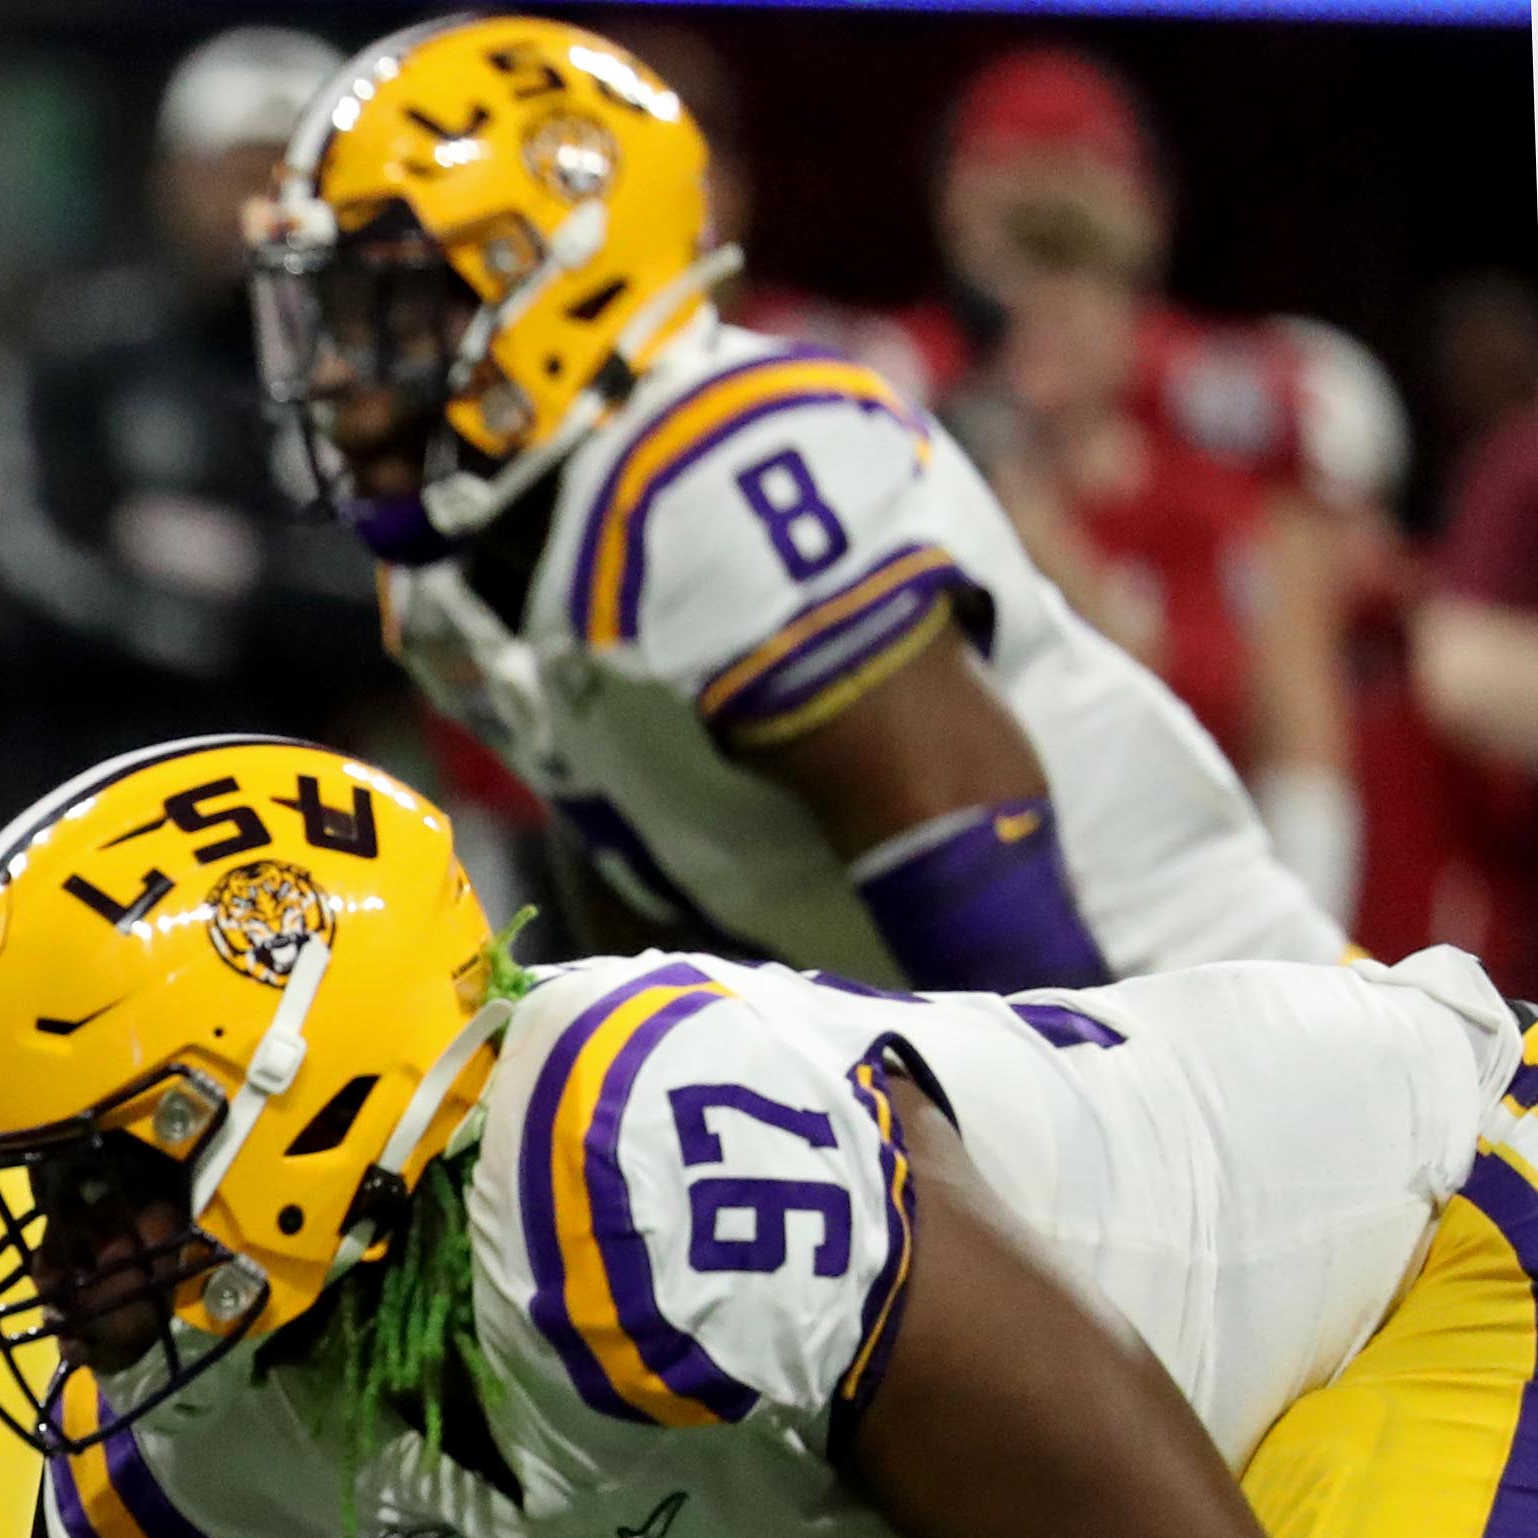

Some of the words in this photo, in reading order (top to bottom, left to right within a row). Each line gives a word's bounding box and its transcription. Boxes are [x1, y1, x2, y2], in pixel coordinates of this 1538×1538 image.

[738, 449, 848, 582] 8
[62, 775, 378, 934] LSU
[667, 1083, 852, 1278] 97
